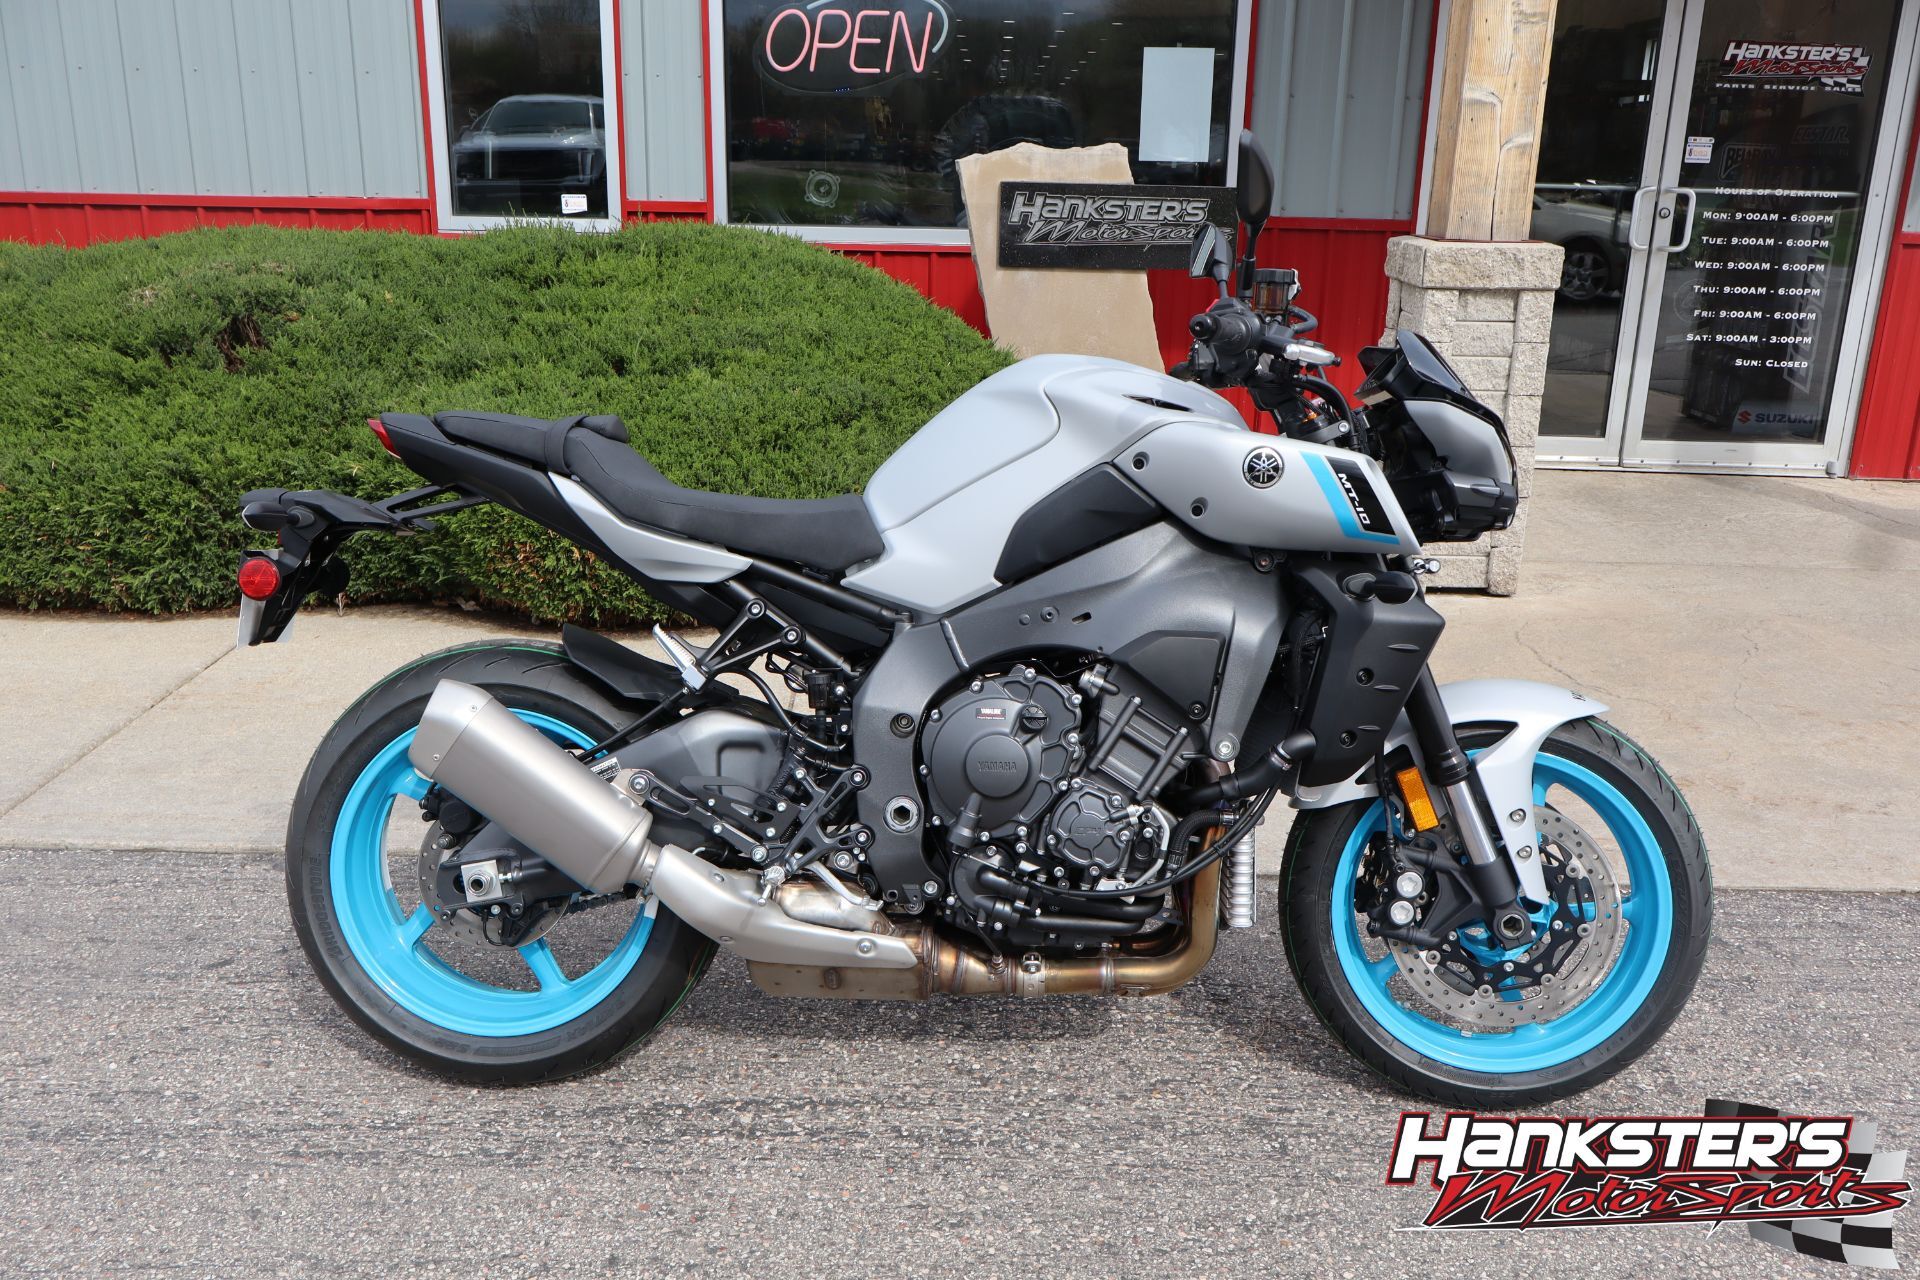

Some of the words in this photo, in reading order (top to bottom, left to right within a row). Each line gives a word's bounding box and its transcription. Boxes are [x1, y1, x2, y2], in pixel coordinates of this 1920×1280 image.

[766, 8, 934, 74] OPEN
[1791, 215, 1834, 224] 6:00PM
[1731, 237, 1775, 246] 9:00AM
[1786, 239, 1829, 248] 6:00PM
[1727, 262, 1771, 271] 9:00AM
[1782, 263, 1825, 272] 6:00PM
[1723, 286, 1767, 295] 9:00AM
[1778, 287, 1821, 297] 6:00PM
[1719, 310, 1763, 319] 9:00AM
[1774, 311, 1816, 321] 6:00PM
[1715, 334, 1759, 343] 9:00AM
[1770, 335, 1812, 345] 3:00PM
[1755, 412, 1814, 425] SUZUKI
[1337, 473, 1371, 525] MT-10
[978, 761, 1017, 771] YAMAHA
